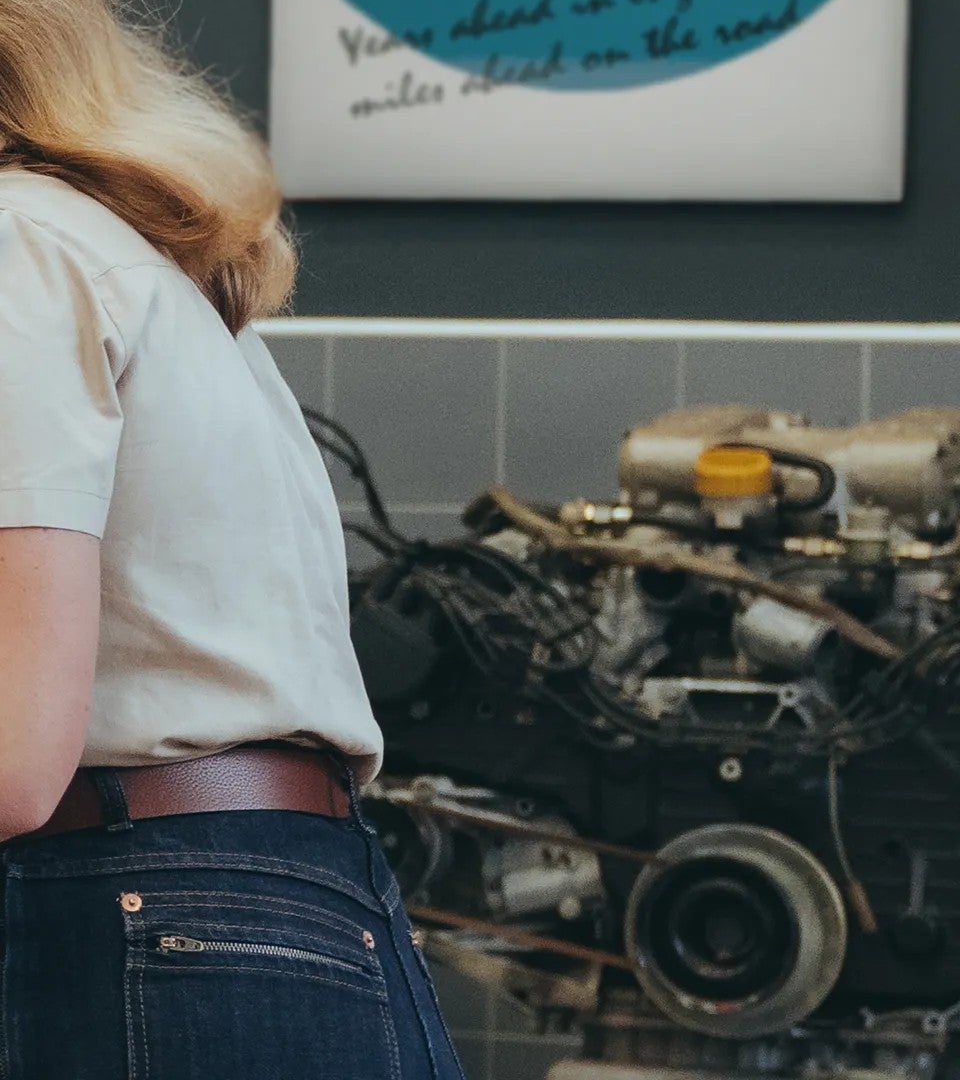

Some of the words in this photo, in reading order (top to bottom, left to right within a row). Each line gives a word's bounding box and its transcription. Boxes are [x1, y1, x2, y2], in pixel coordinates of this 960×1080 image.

[338, 27, 433, 66] Years
[350, 74, 445, 119] miles
[459, 43, 564, 97] ahead
[582, 46, 632, 72] on
[643, 18, 700, 59] the
